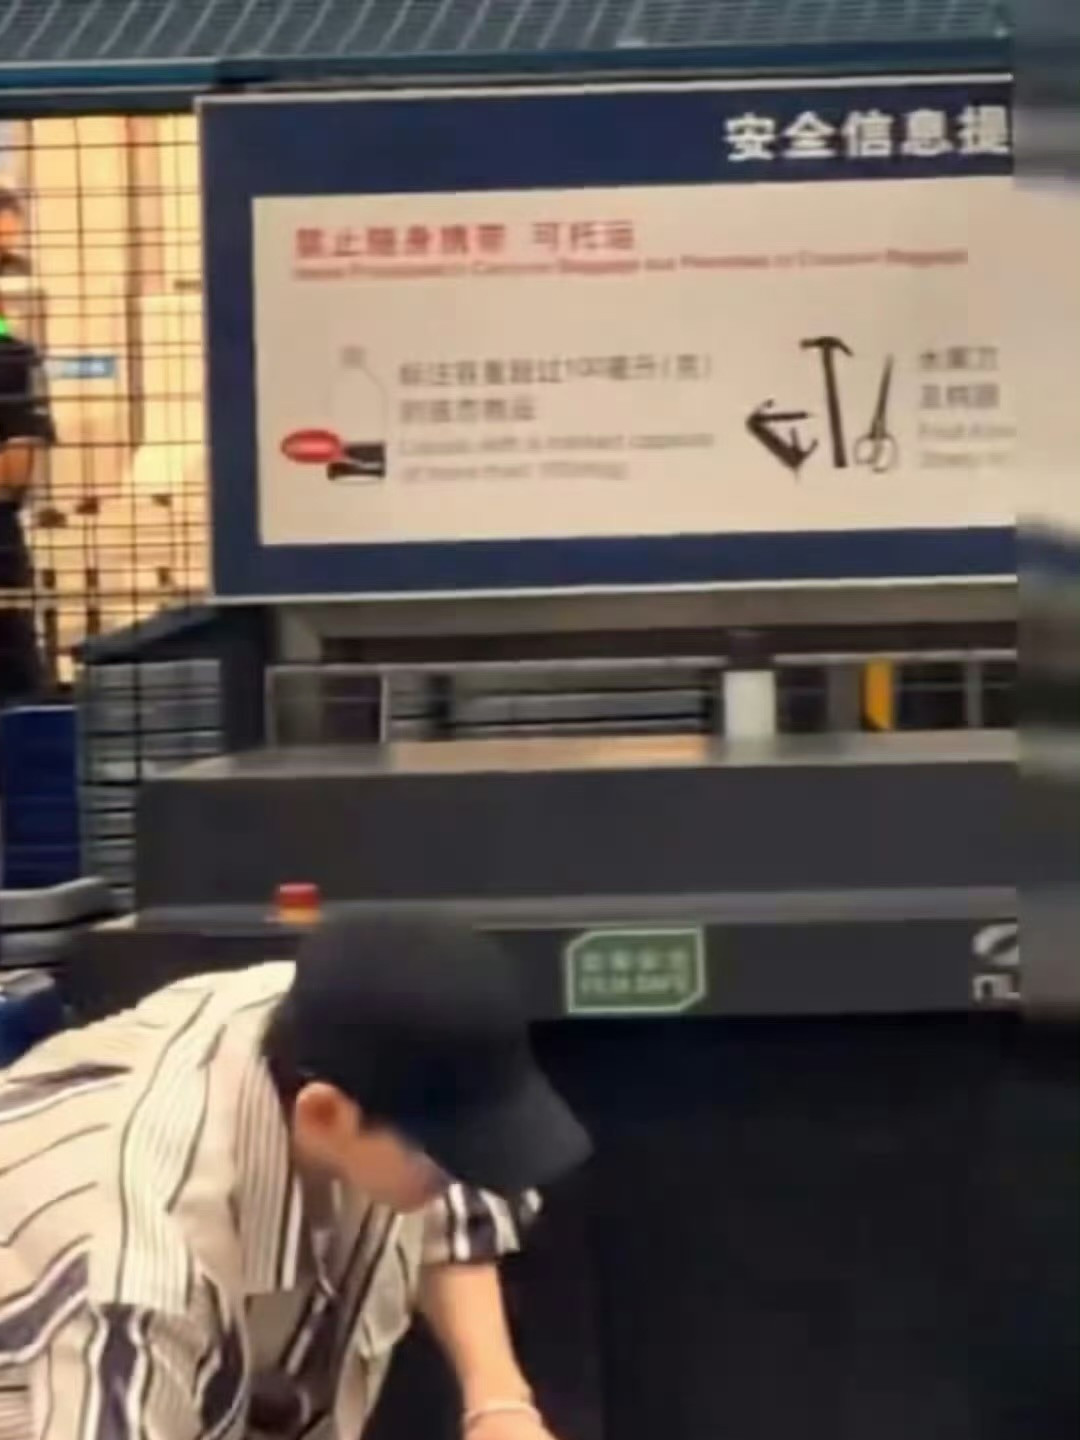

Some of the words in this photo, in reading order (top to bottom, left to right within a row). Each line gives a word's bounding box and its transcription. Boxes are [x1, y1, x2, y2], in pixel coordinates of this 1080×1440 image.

[725, 105, 1010, 161] 安全信息提
